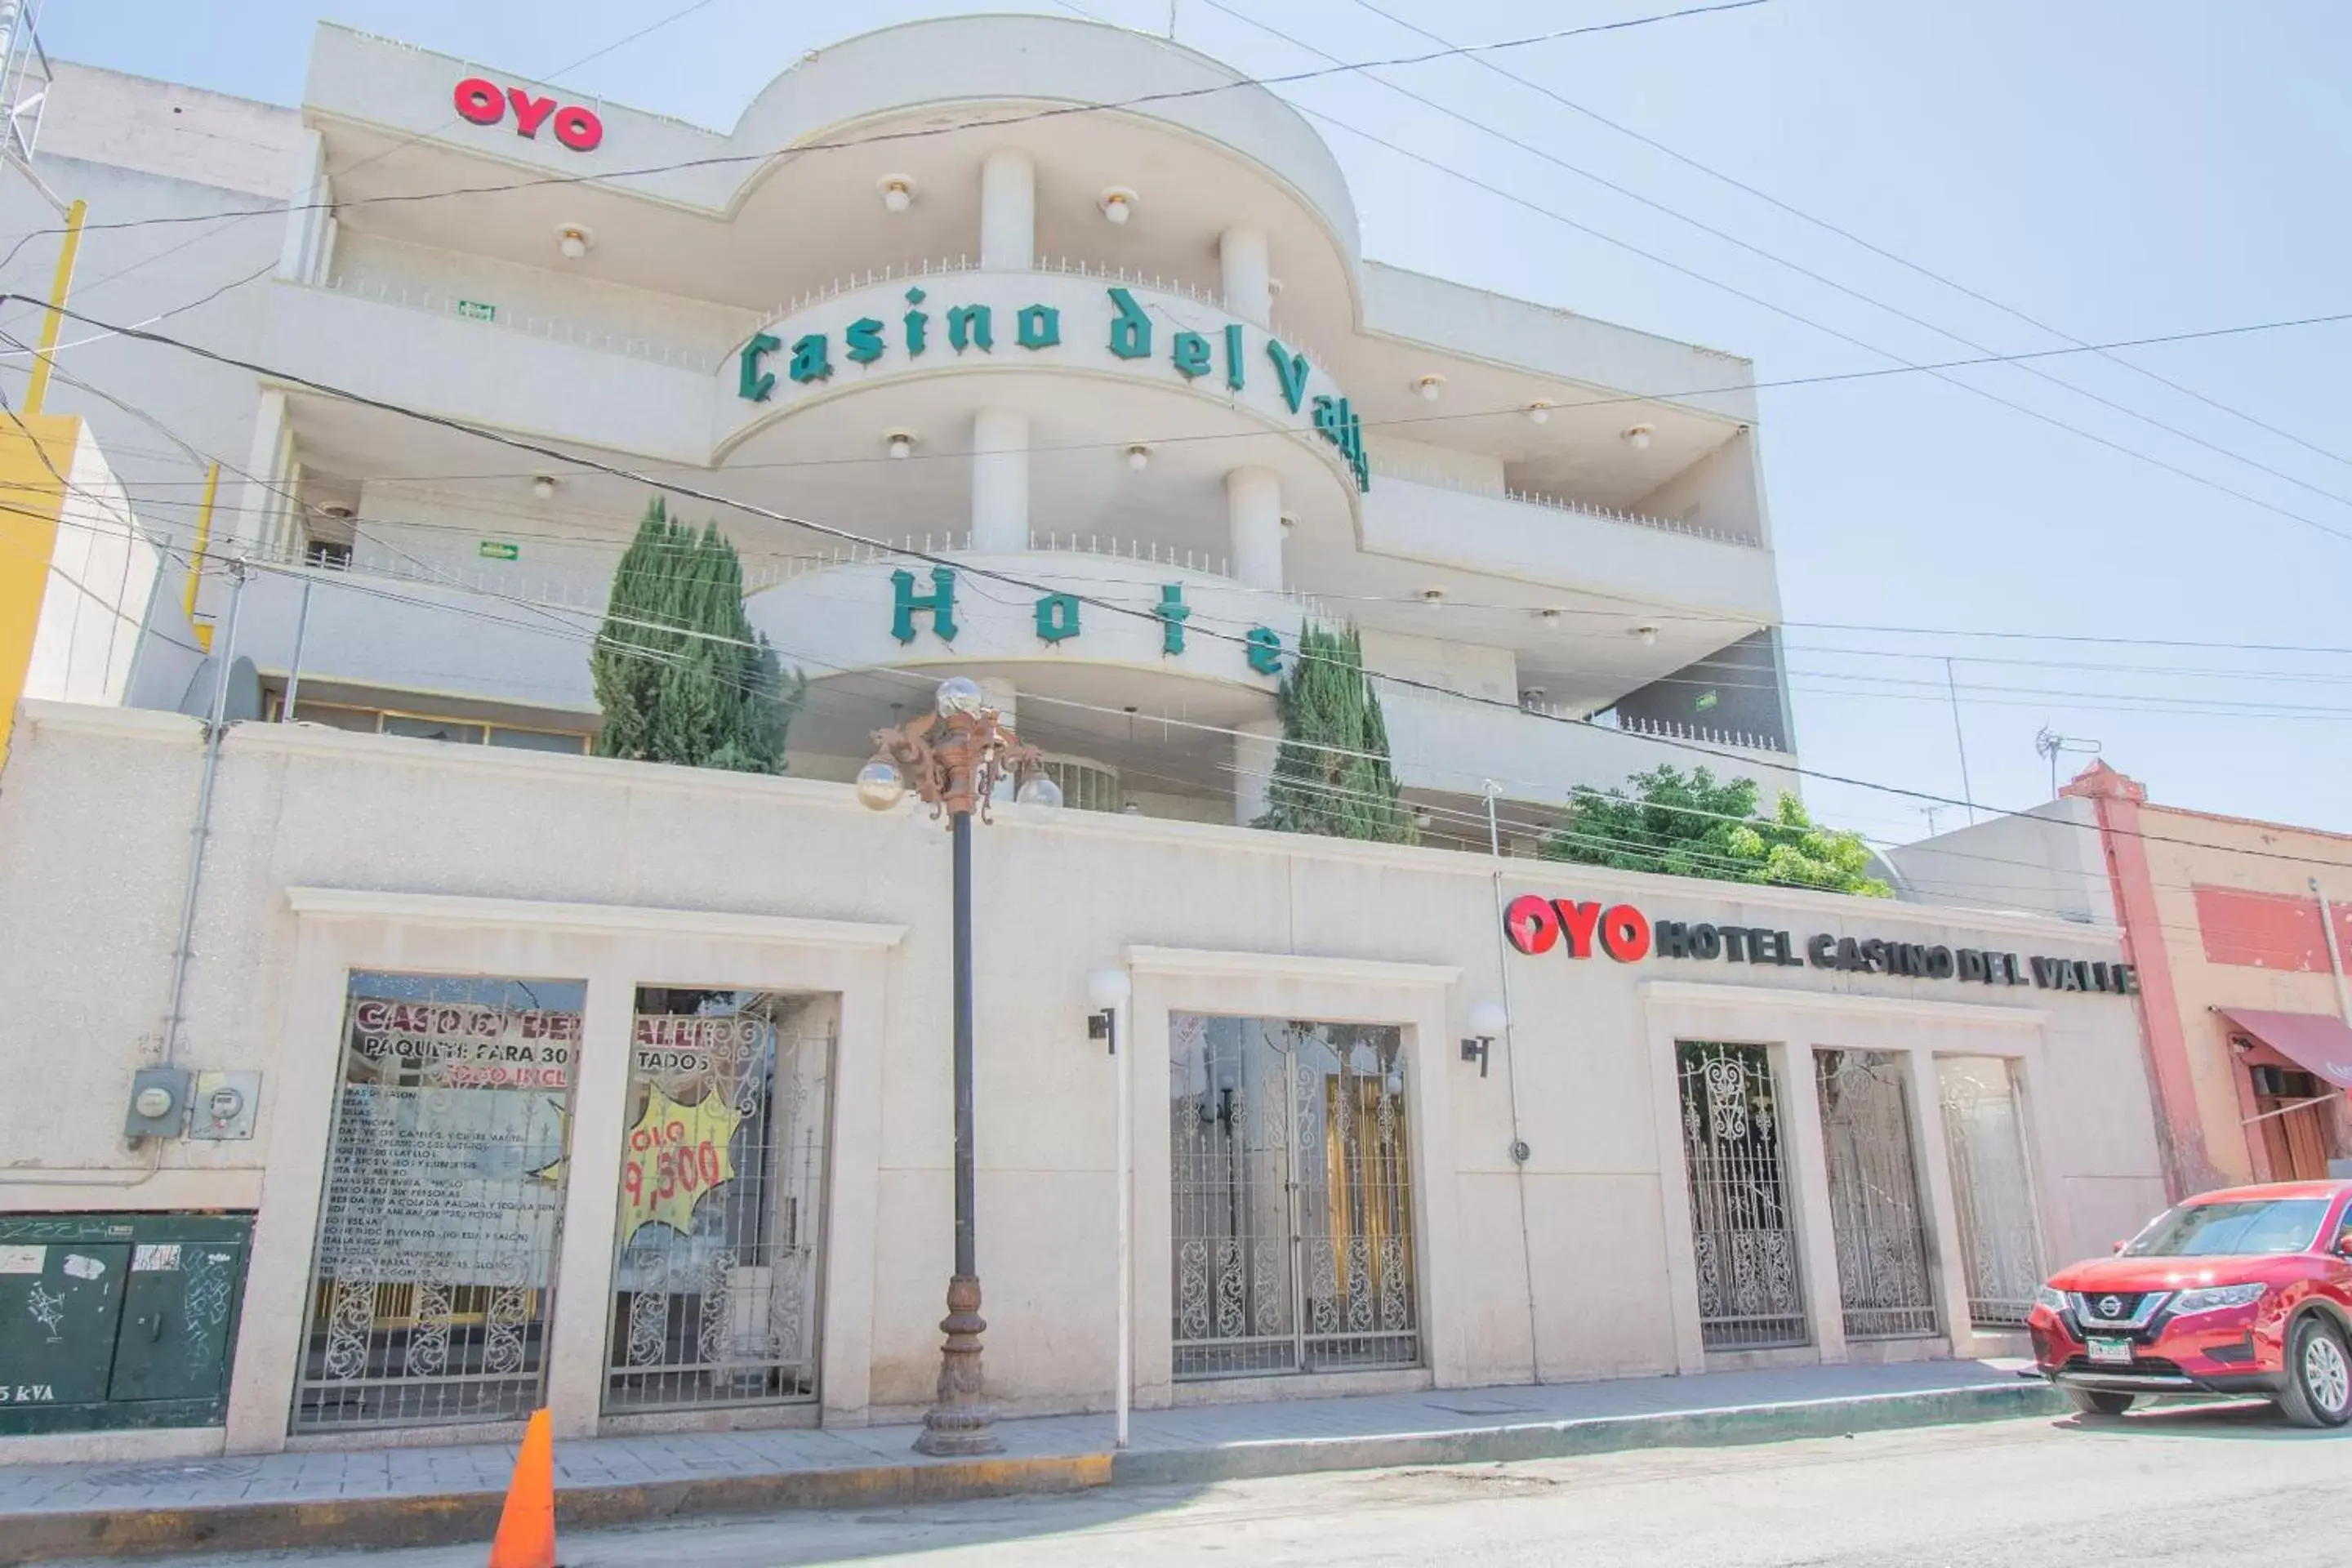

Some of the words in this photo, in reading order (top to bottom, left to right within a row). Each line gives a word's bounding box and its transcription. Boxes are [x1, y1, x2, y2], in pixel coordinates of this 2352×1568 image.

[454, 78, 603, 152] OYO
[737, 286, 1061, 402] Casino
[1107, 288, 1245, 391] del
[891, 565, 1284, 676] Hote
[1503, 894, 1650, 964] OYO
[1655, 920, 1804, 968] HOTEL
[1807, 933, 1954, 980] CASINO
[1957, 948, 2029, 986] DEL
[2030, 956, 2140, 995] VALLE
[637, 1019, 714, 1047] ALLE
[516, 1066, 566, 1085] INCL
[639, 1051, 708, 1071] TADOS
[630, 1121, 685, 1152] OLO
[15, 1384, 56, 1401] kVA
